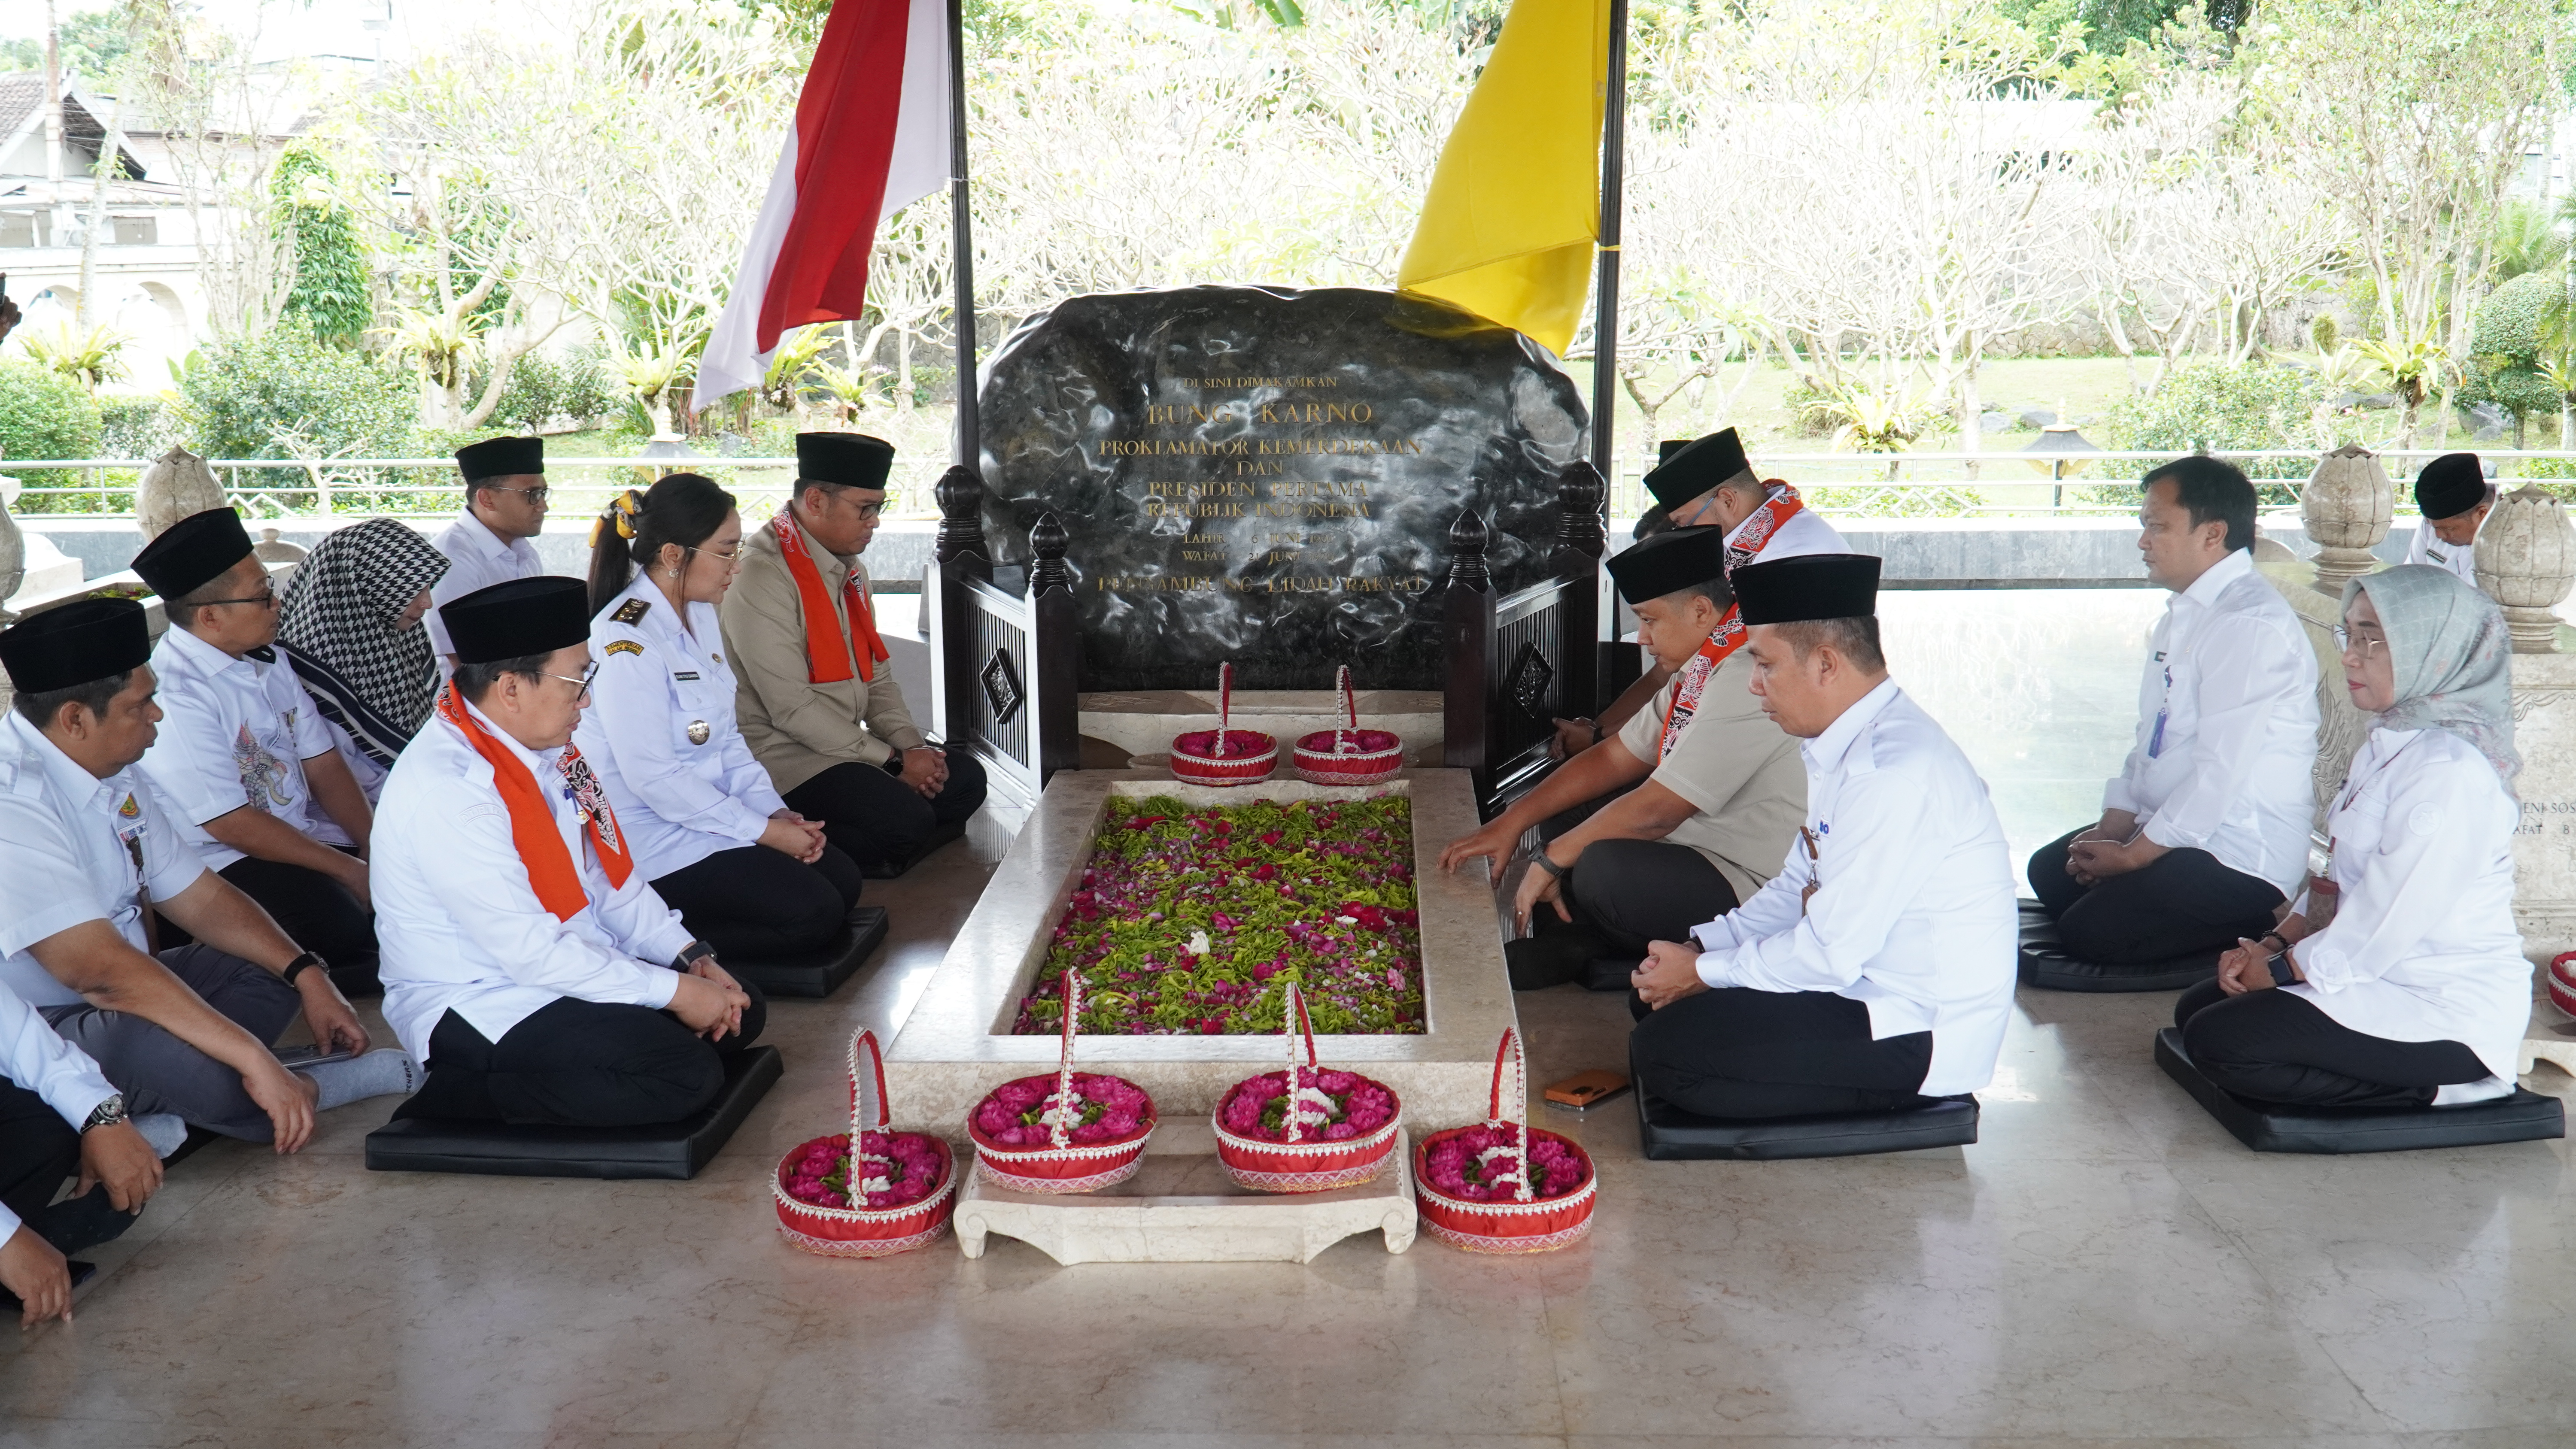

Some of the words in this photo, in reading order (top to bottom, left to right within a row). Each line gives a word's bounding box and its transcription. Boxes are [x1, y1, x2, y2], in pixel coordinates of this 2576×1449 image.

[1183, 377, 1198, 388] DI
[1204, 378, 1231, 388] SINI
[1237, 377, 1337, 387] DIMAKAMKAN
[1148, 404, 1230, 424] BUNG
[1261, 403, 1371, 423] KARNO
[1099, 440, 1250, 455] PROKLAMATOR
[1258, 439, 1422, 455] KEMERDEKAAN
[1236, 461, 1283, 476] DAN
[1148, 482, 1255, 497] PRESIDEN
[1272, 481, 1367, 497] PERTAMA
[1147, 503, 1246, 517] REPUBLIK
[1255, 502, 1370, 517] INDONESIA
[1183, 534, 1226, 543] LAHIR
[1252, 534, 1258, 543] 6
[1269, 533, 1300, 547] JUNI
[1182, 551, 1227, 561] WAFAT
[1249, 552, 1260, 561] 21
[1268, 551, 1300, 565] JUNI
[1097, 577, 1252, 592] PENYAMBUNG
[1269, 576, 1334, 592] LIDAH
[1345, 576, 1424, 592] RAKYAT
[2523, 802, 2544, 813] ENI
[2551, 802, 2576, 813] SOS
[2512, 825, 2543, 834] AFAT
[2564, 825, 2570, 834] 8
